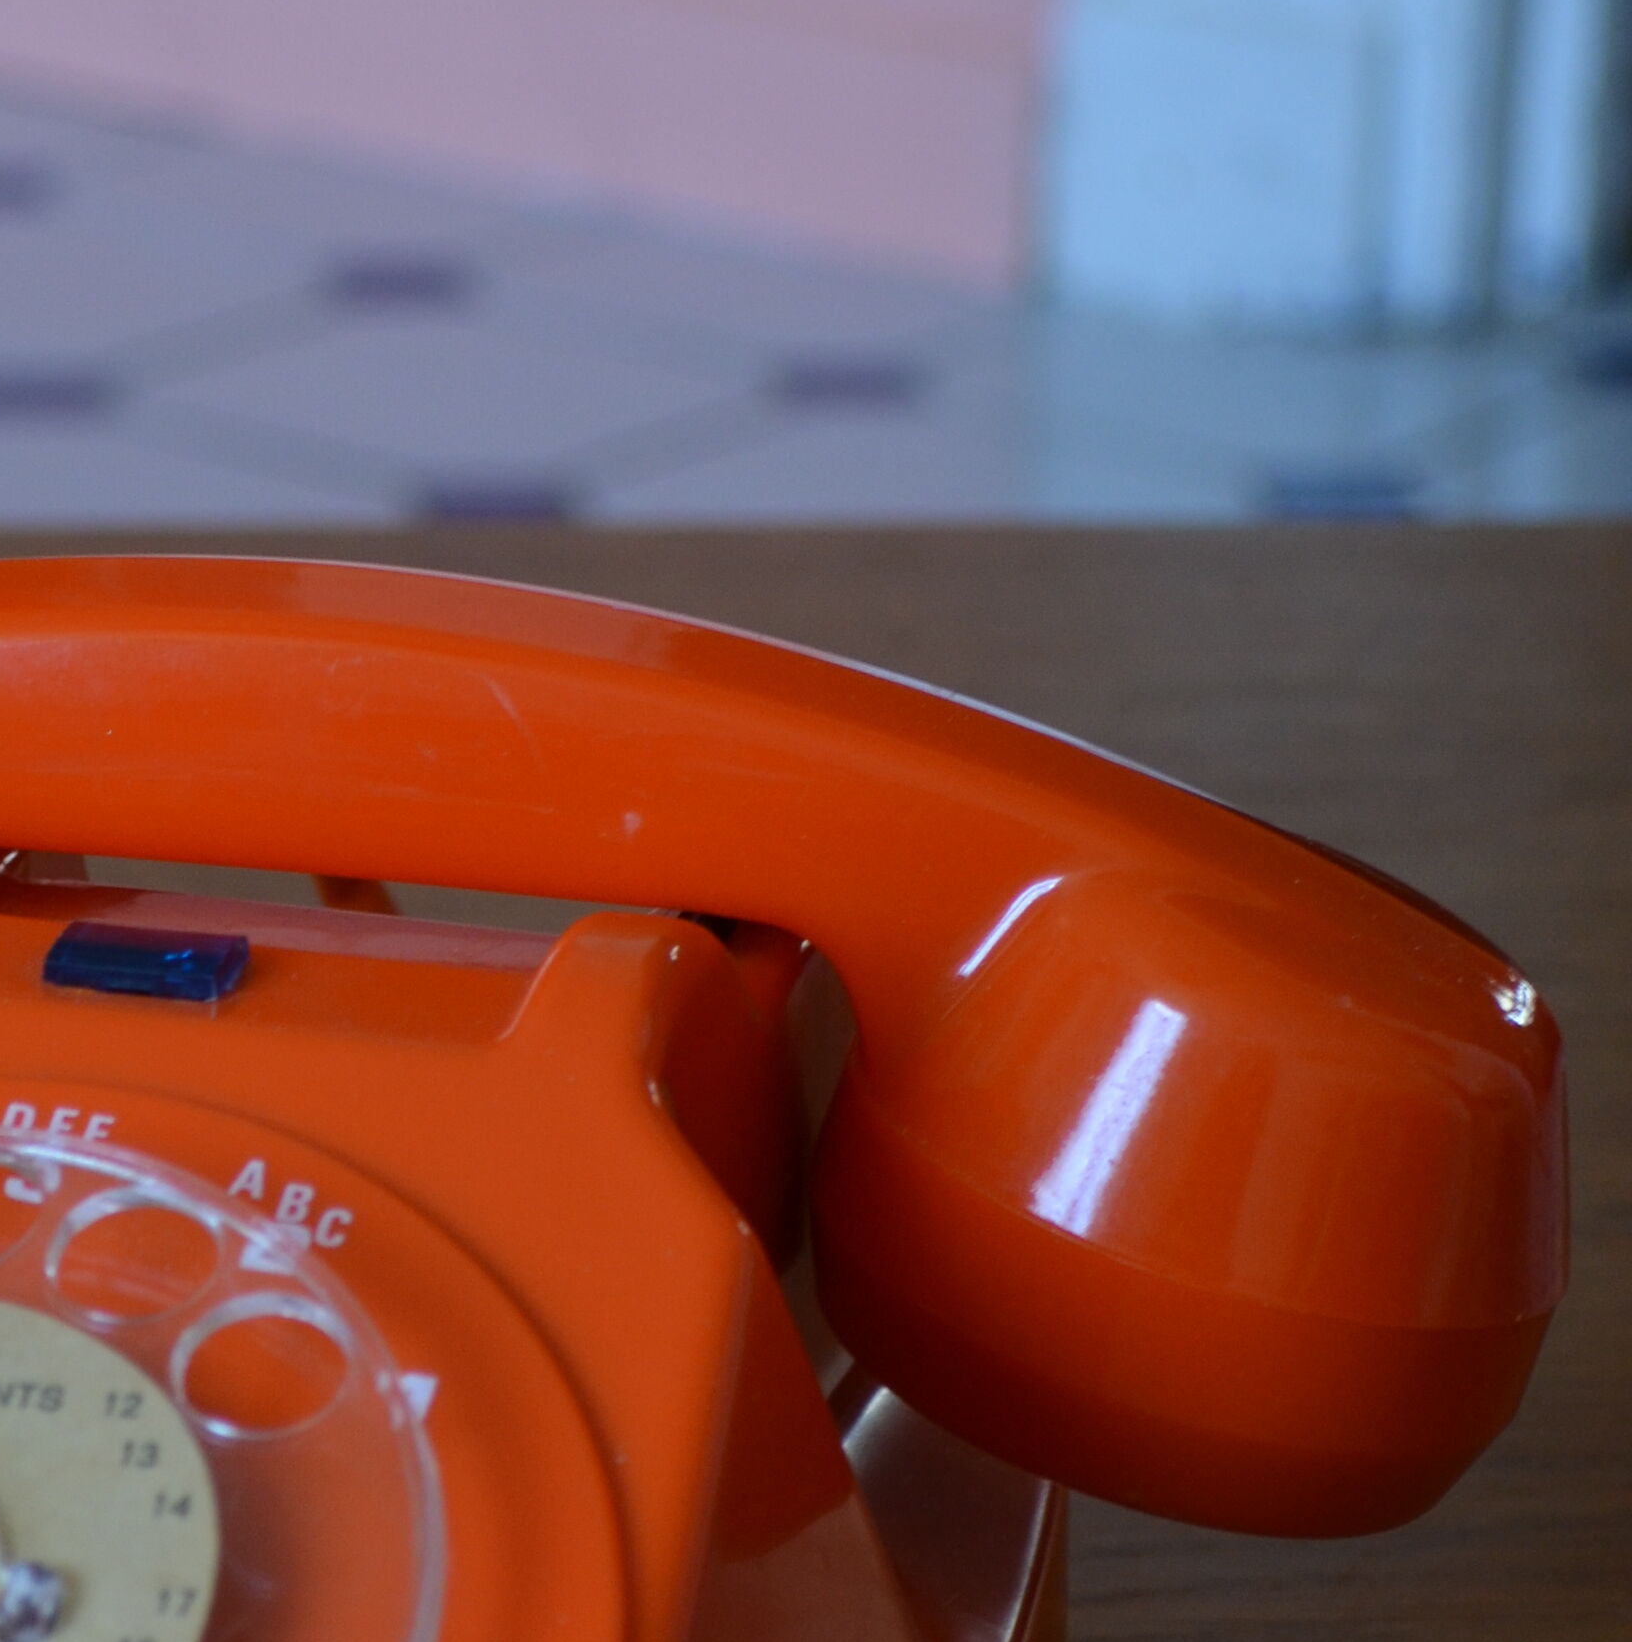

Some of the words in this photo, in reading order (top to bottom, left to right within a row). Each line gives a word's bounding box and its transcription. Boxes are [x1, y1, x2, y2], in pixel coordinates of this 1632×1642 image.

[104, 1391, 145, 1420] 12
[121, 1440, 160, 1469] 13
[153, 1490, 193, 1518] 14
[157, 1587, 198, 1617] 17
